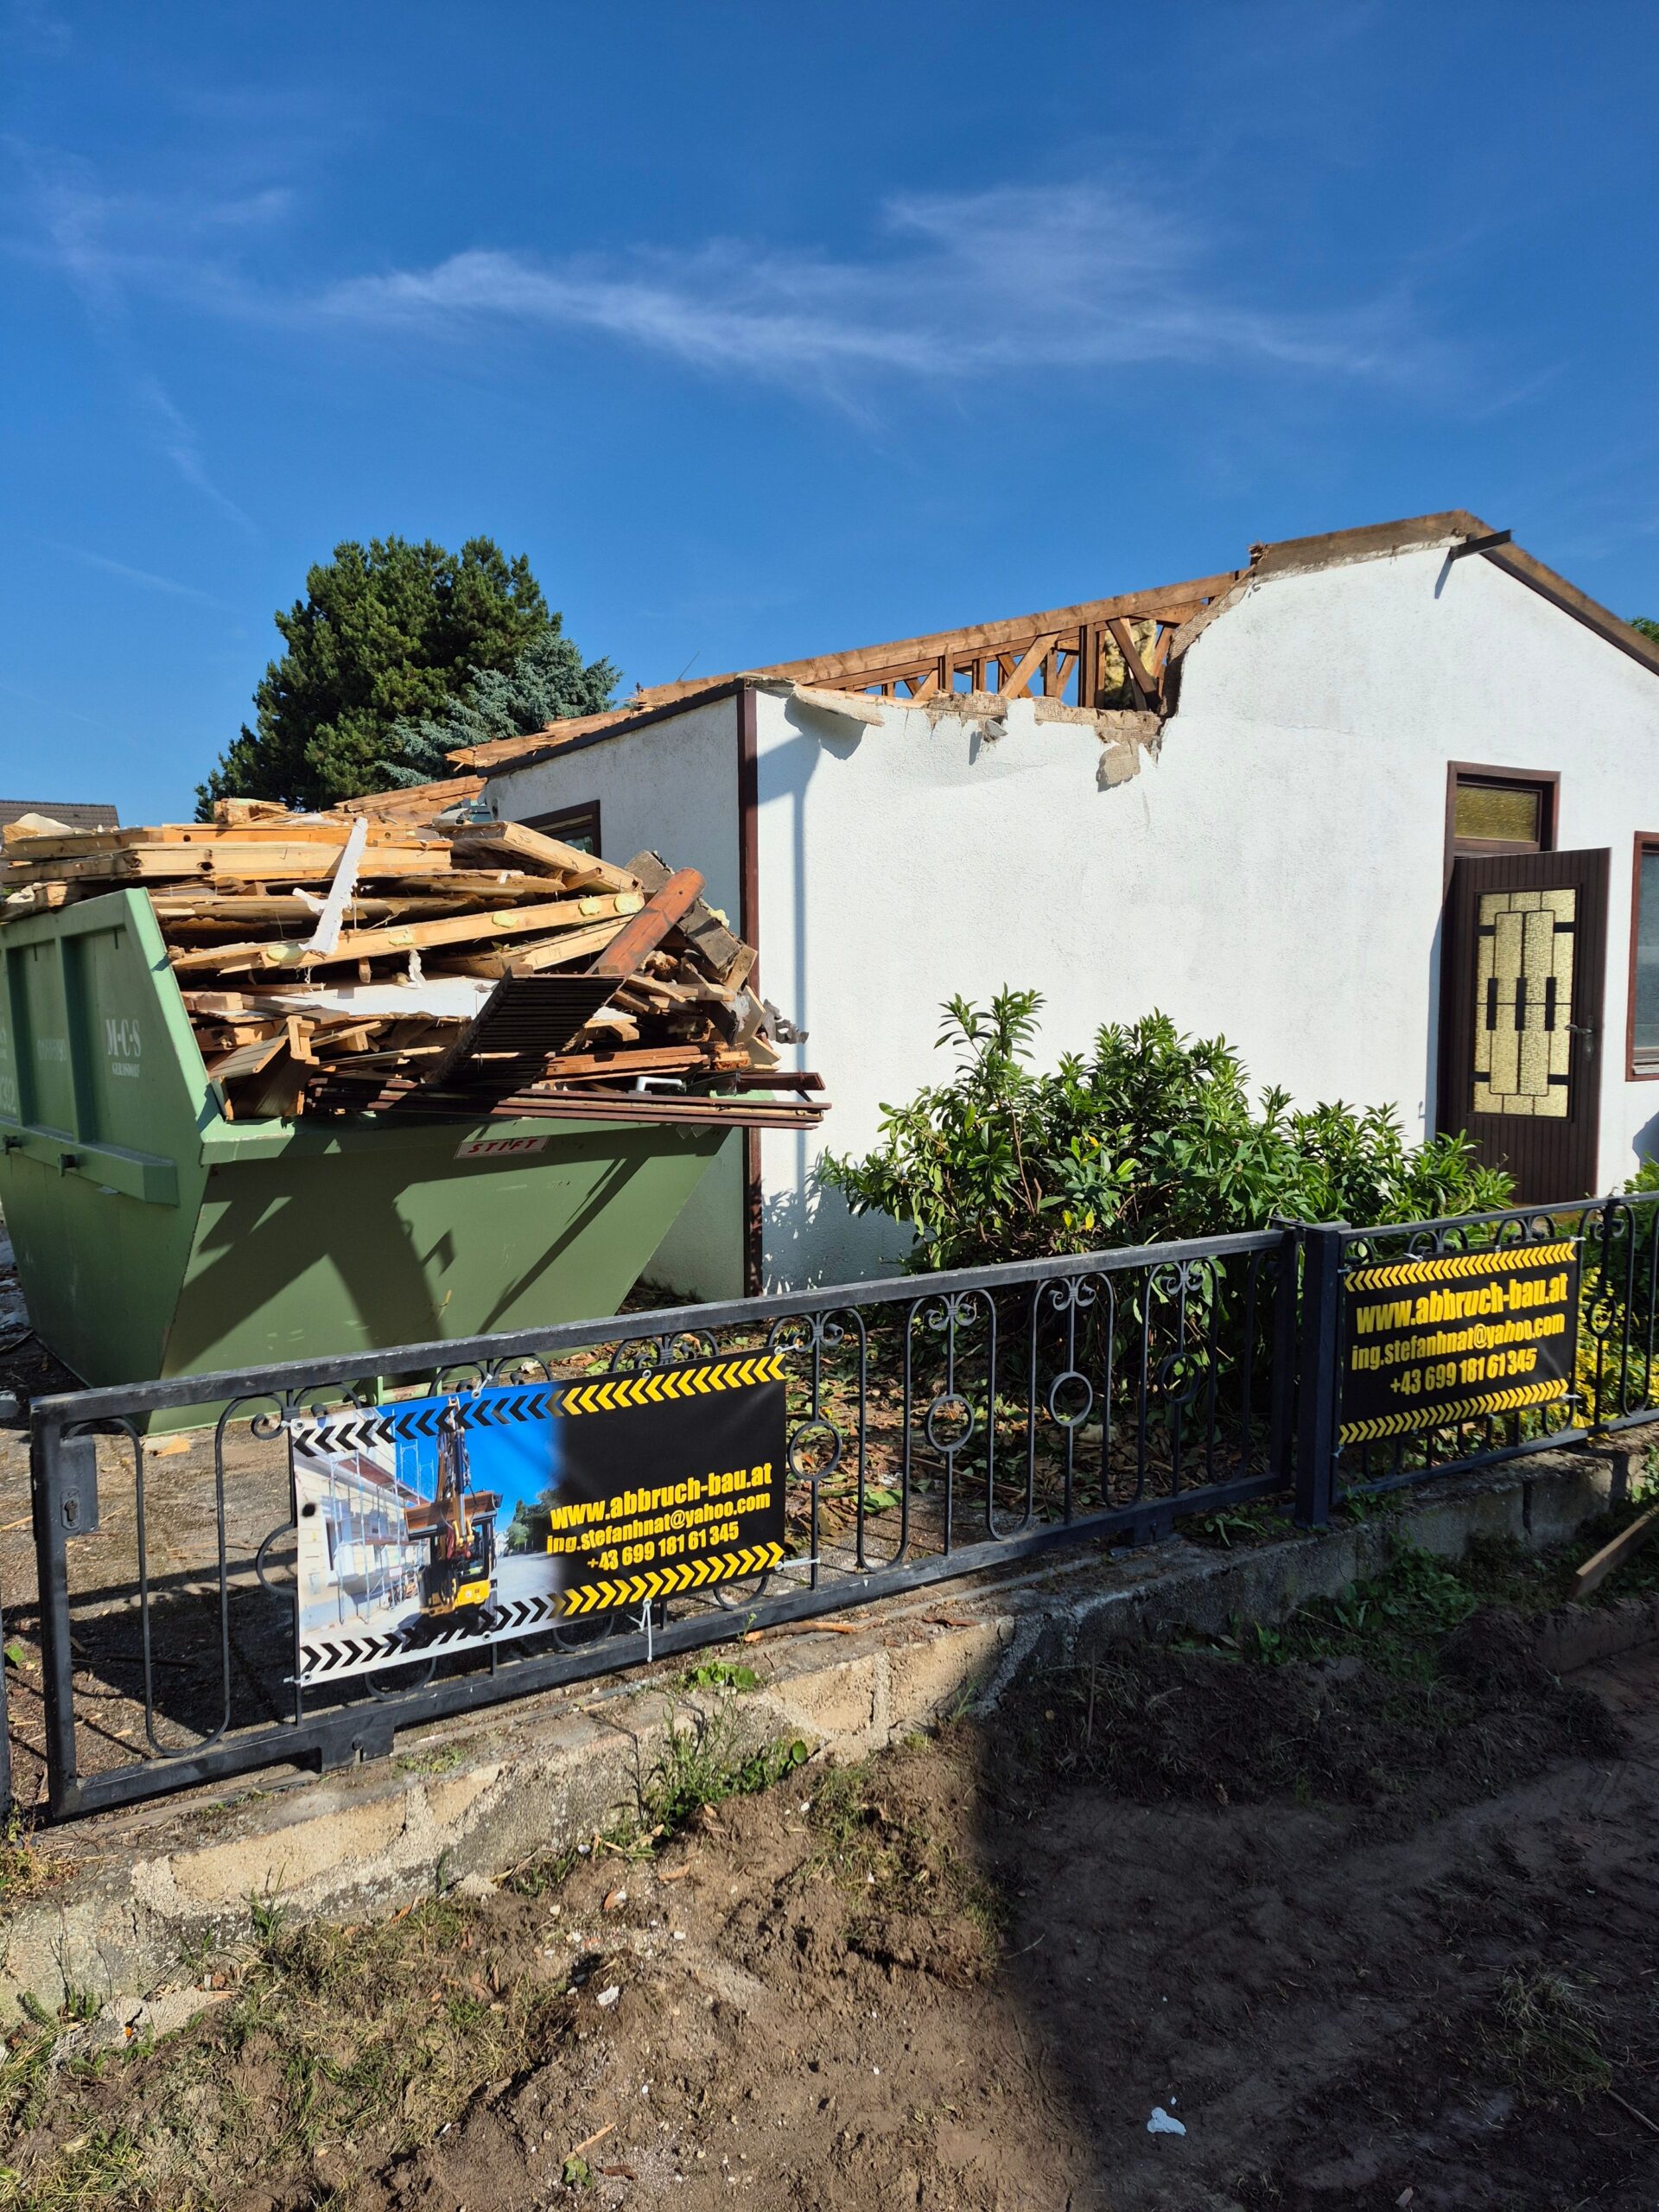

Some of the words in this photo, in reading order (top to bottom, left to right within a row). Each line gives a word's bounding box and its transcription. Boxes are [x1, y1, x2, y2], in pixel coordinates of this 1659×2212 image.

[467, 1139, 538, 1154] STIFT
[1356, 1273, 1567, 1334] www.abbruch-bau.at
[1351, 1313, 1565, 1370] ing.stefanhnat@yahoo.com
[1390, 1369, 1421, 1395] +43
[1425, 1362, 1457, 1391] 699
[1459, 1357, 1484, 1383] 181
[1487, 1353, 1505, 1378] 61
[1507, 1348, 1537, 1374] 345
[546, 1493, 771, 1554] ing.stefanhnat@yahoo.com
[550, 1462, 772, 1530] www.abbruch-bau.at
[587, 1550, 619, 1571] +43
[622, 1541, 655, 1567] 699
[658, 1535, 684, 1557] 181
[688, 1529, 706, 1550] 61
[709, 1522, 739, 1546] 345
